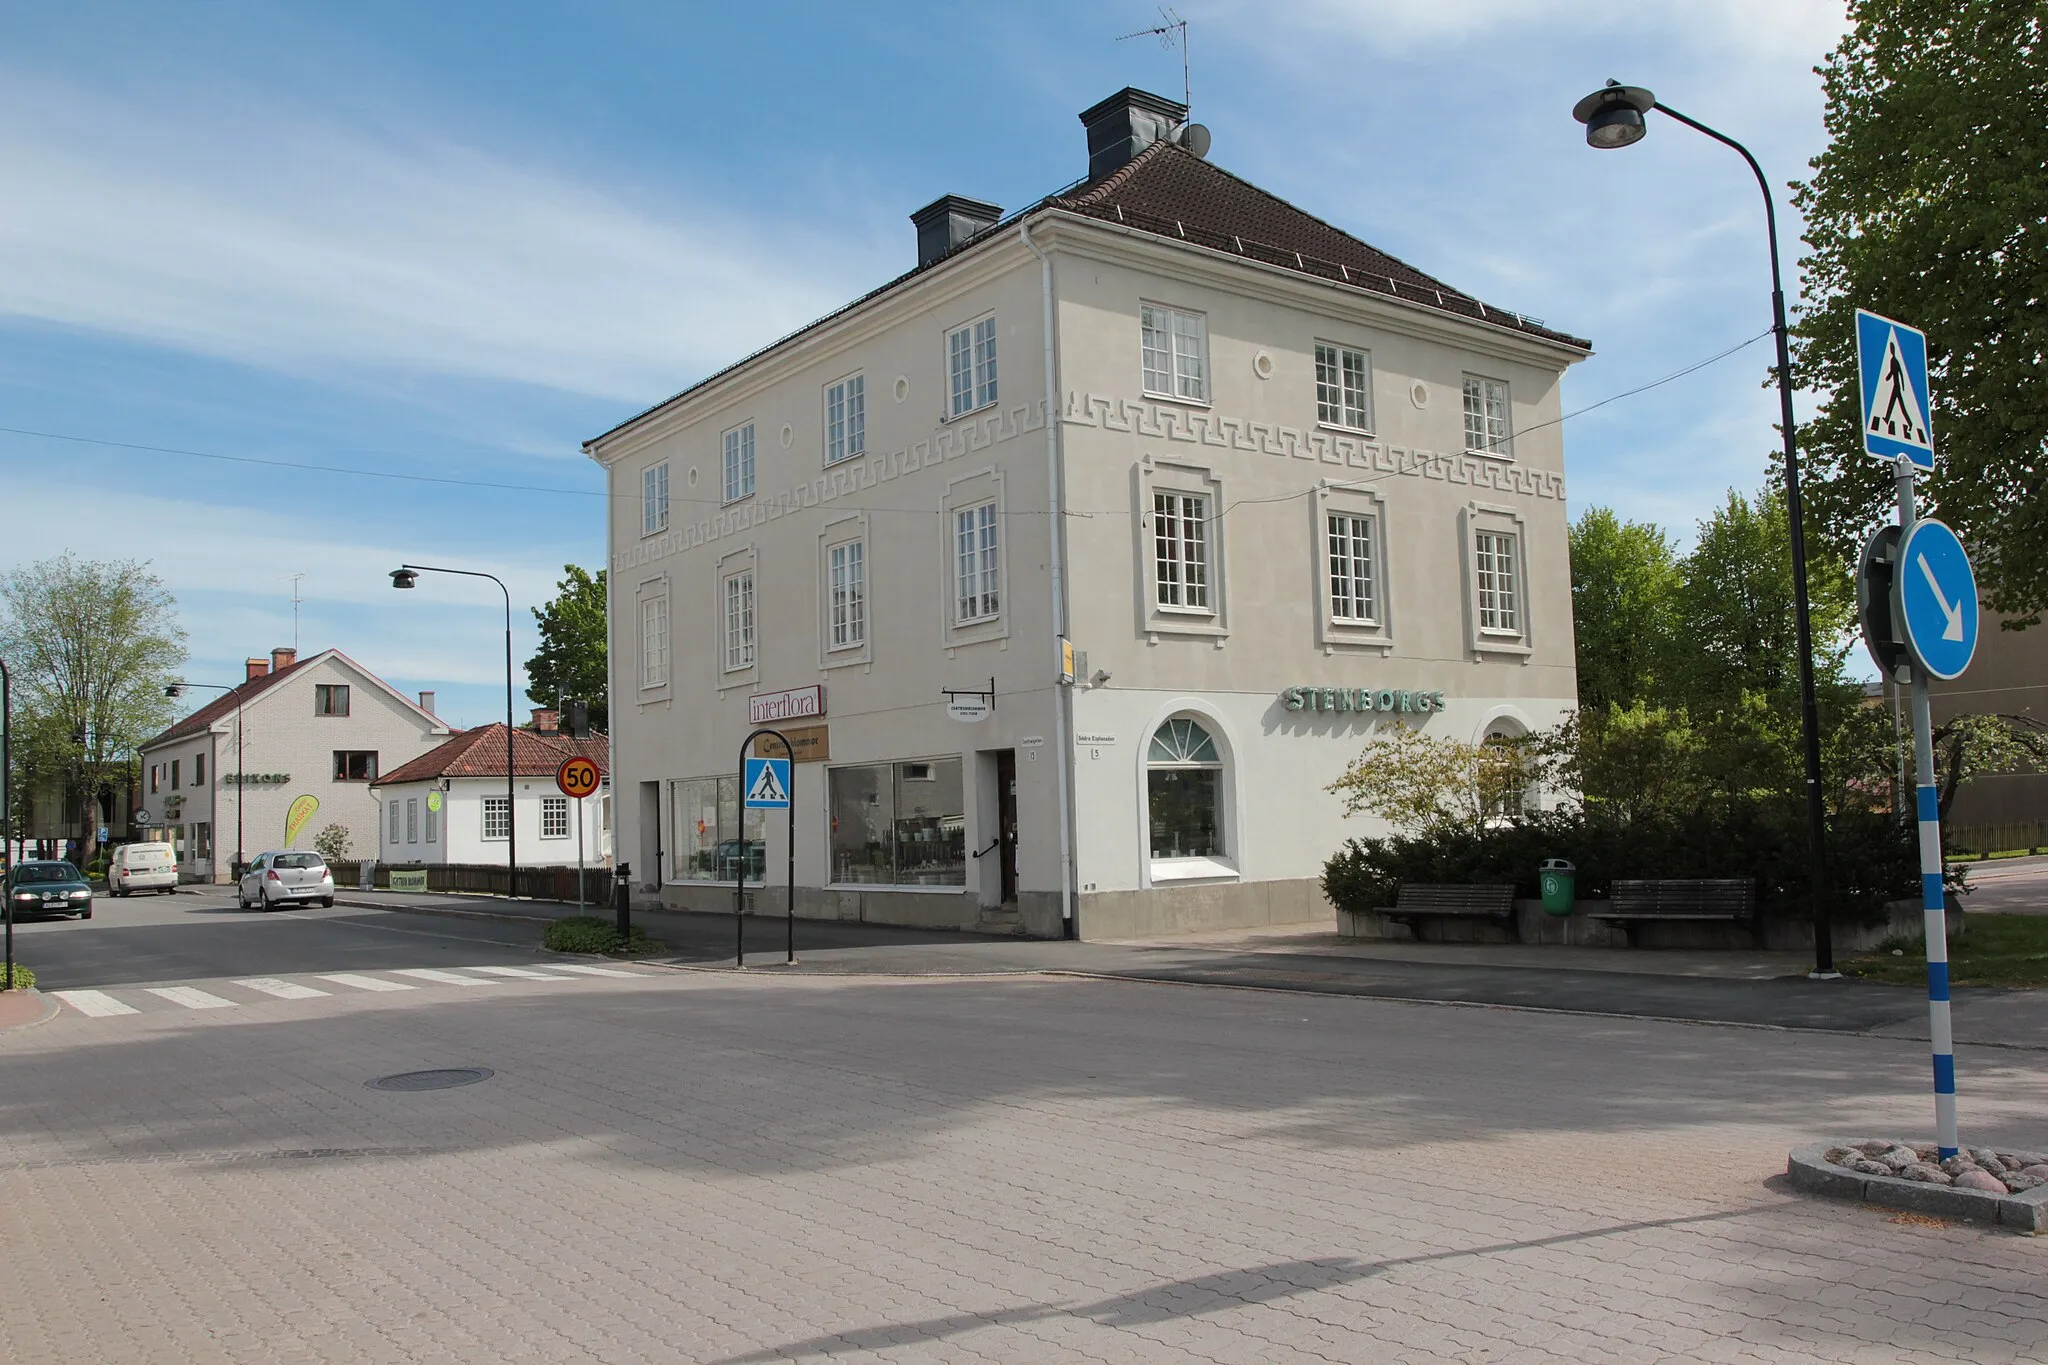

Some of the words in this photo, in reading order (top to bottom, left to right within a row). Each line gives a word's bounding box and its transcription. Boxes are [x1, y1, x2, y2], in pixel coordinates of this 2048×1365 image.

[753, 693, 815, 721] interflora
[1284, 686, 1446, 712] STENBORGS
[1095, 749, 1099, 757] 5
[567, 768, 593, 787] 50
[288, 803, 313, 831] THAIMAT
